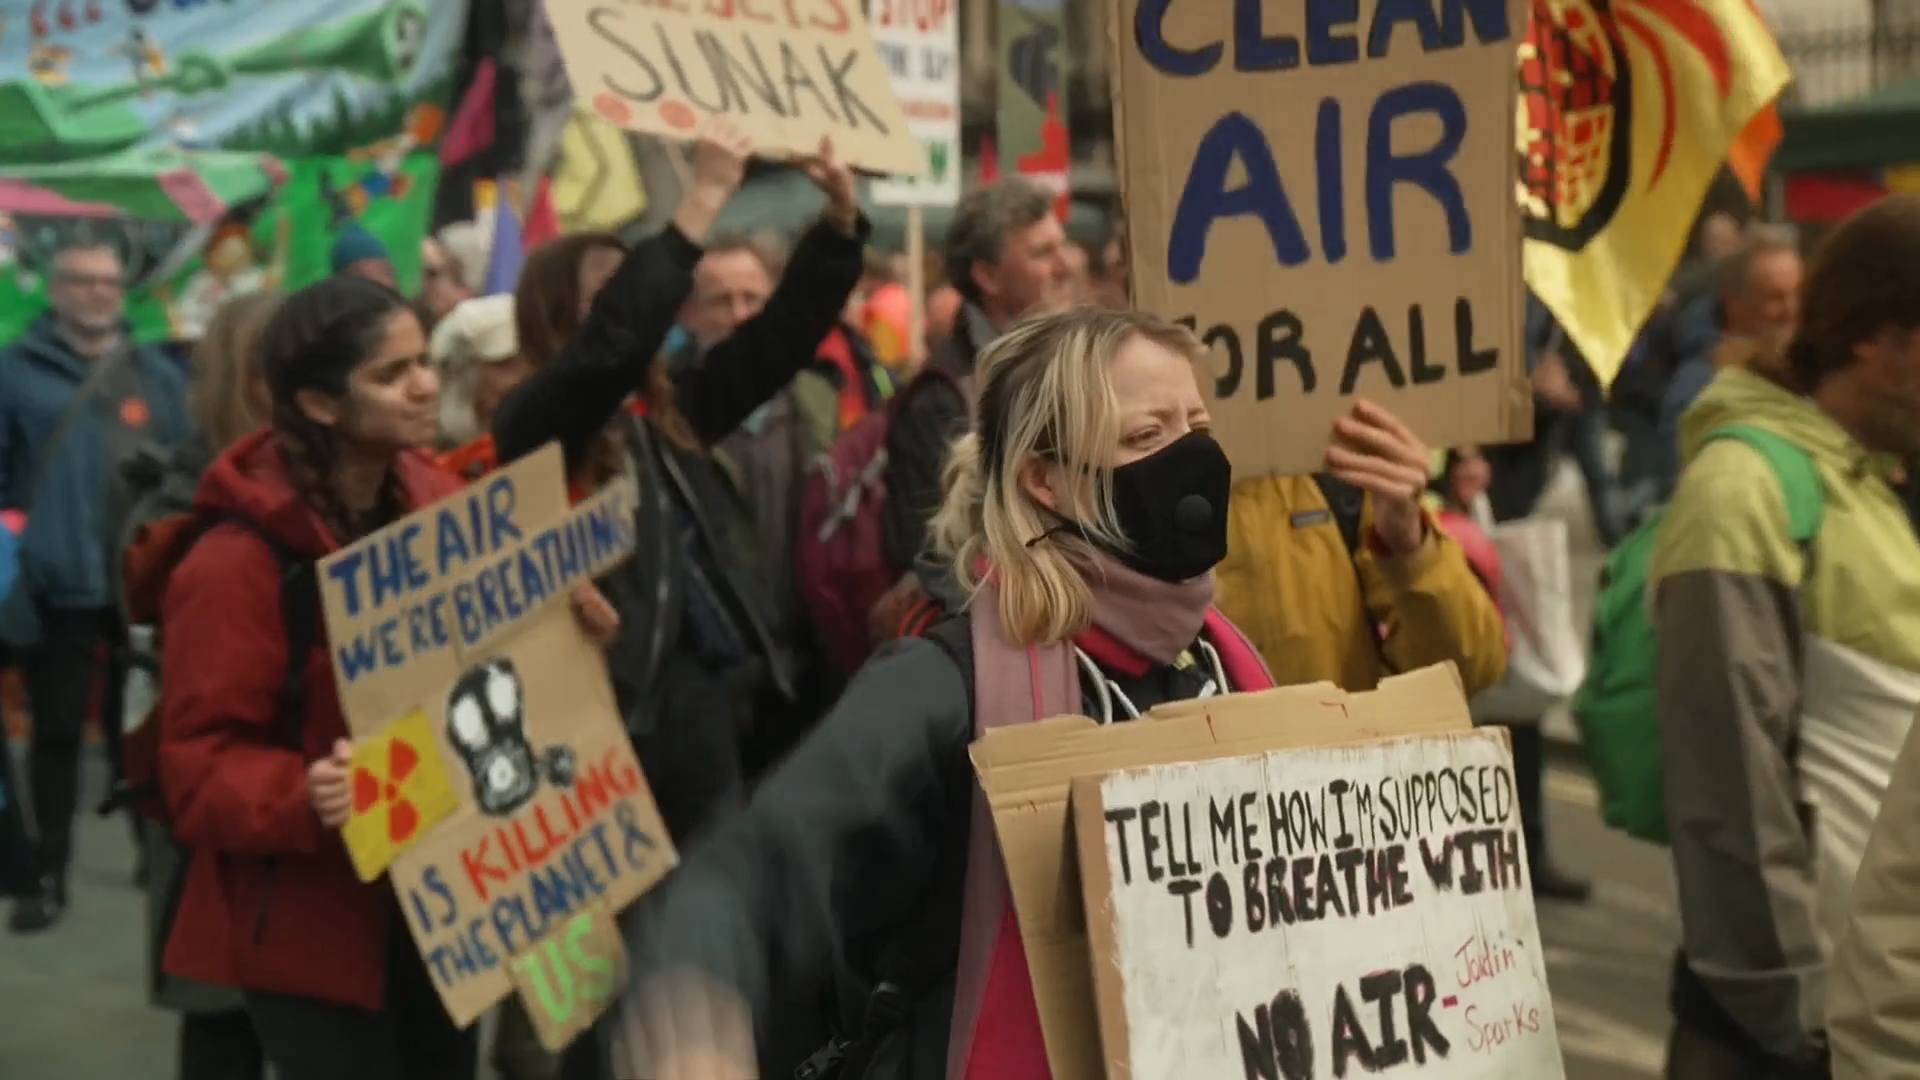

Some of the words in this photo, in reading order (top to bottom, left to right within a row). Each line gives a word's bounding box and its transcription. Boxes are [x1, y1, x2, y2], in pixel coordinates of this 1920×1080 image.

[585, 5, 891, 136] SUNAK
[1134, 0, 1511, 76] CLEAN
[1167, 80, 1472, 284] AIR
[1171, 309, 1318, 401] OR
[1339, 297, 1498, 396] ALL
[328, 522, 430, 620] THE
[436, 474, 523, 577] AIR
[408, 863, 457, 934] IS
[459, 748, 639, 903] KILLING
[1103, 799, 1203, 886] TELL
[1208, 790, 1263, 867] ME
[1266, 783, 1328, 856] HOW
[1328, 778, 1377, 849] I'M
[1377, 764, 1513, 844] SUPPOSED
[428, 917, 497, 987] THE
[490, 821, 622, 954] PLANET
[611, 799, 658, 873] &
[1166, 871, 1235, 948] TO
[1242, 843, 1415, 933] BREATHE
[1418, 828, 1522, 896] WITH
[510, 912, 614, 1023] US
[1235, 986, 1316, 1080] NO
[1331, 963, 1452, 1080] AIR
